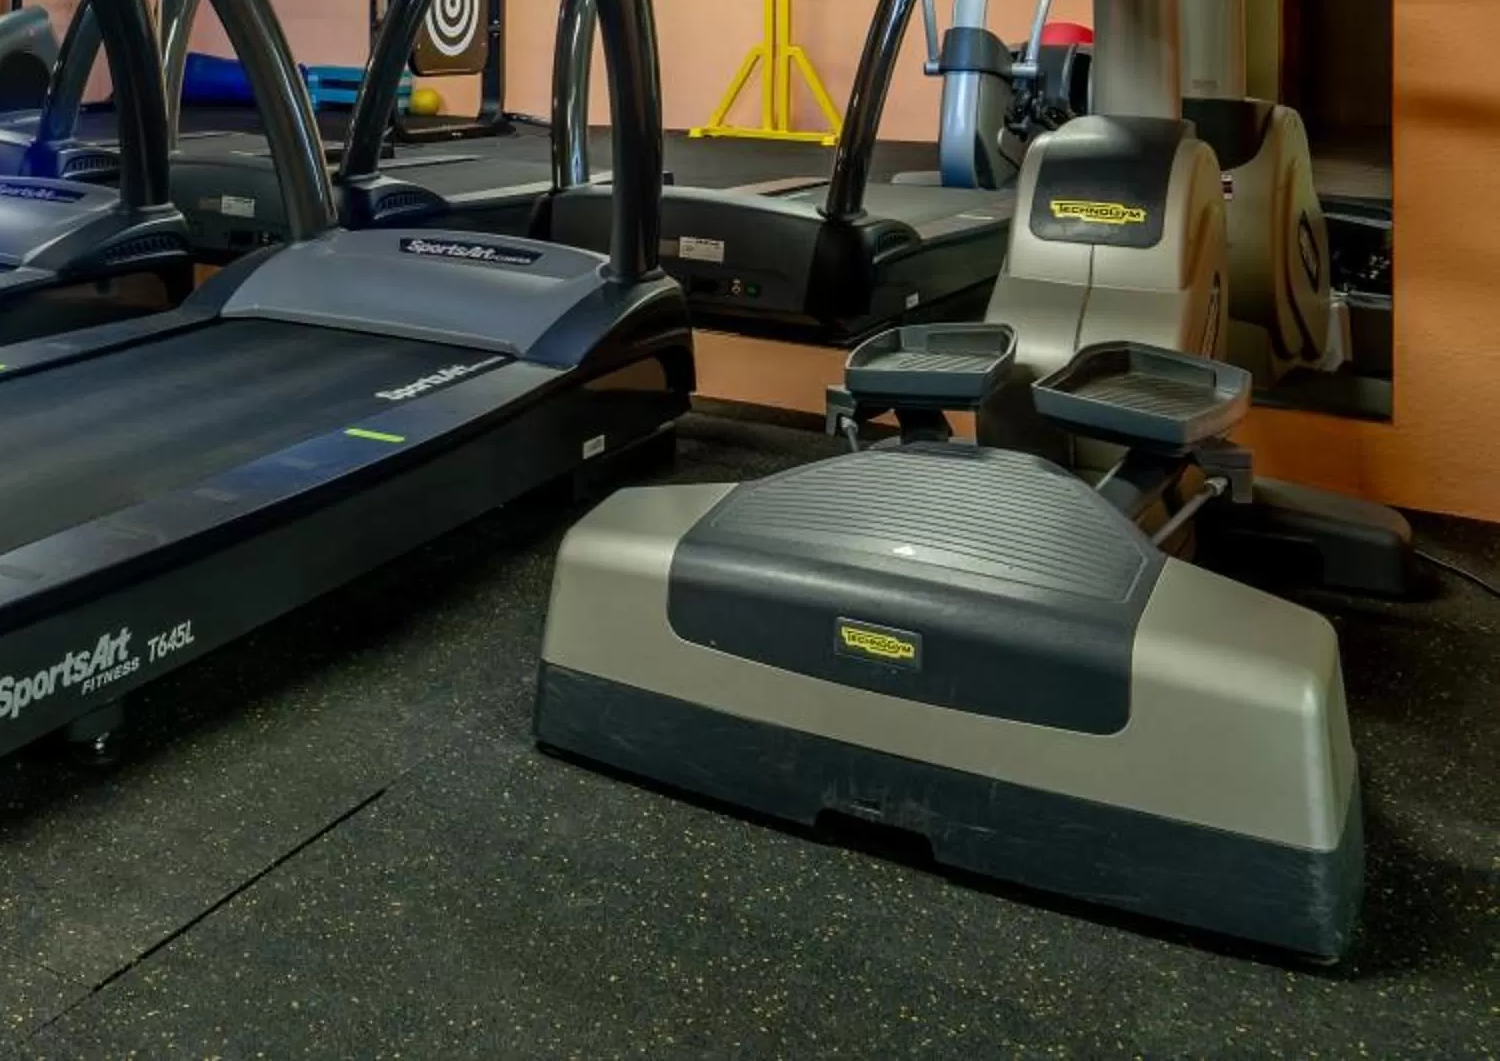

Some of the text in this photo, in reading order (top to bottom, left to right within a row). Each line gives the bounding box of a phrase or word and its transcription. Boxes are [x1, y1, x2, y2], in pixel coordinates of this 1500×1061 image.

[406, 238, 496, 260] SportsArt
[148, 619, 195, 663] T645L
[80, 656, 141, 695] FITNESS
